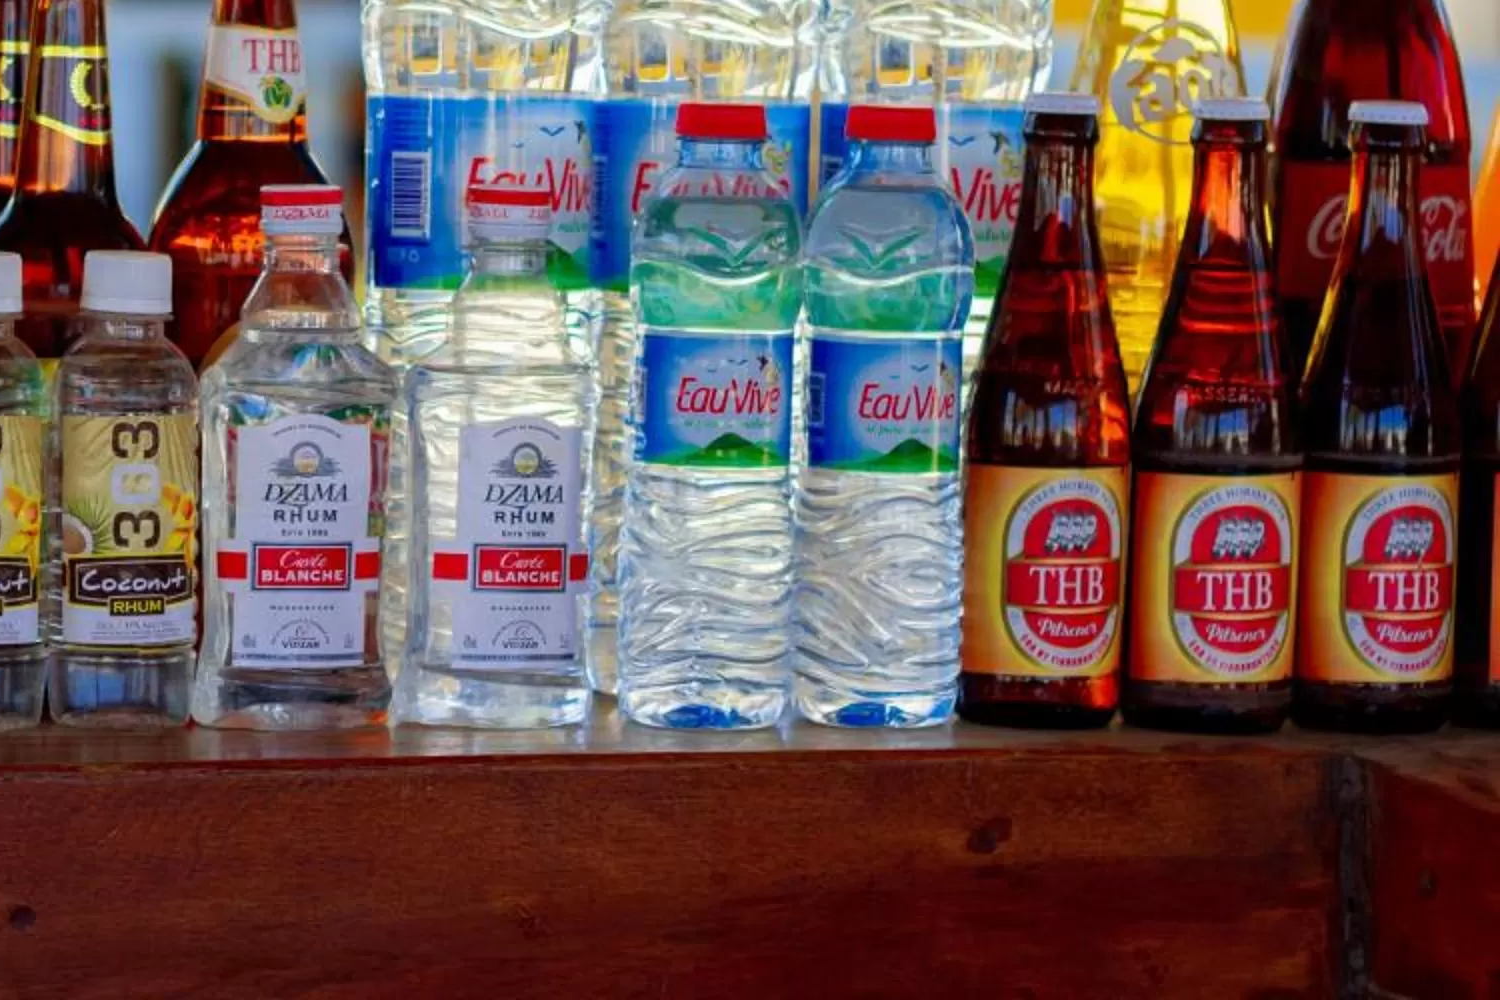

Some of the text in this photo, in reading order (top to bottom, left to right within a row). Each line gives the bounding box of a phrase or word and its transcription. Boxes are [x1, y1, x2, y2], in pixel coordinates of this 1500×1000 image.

[264, 483, 348, 506] DZAMA
[483, 484, 564, 507] DZAMA
[273, 509, 338, 523] RHUM
[494, 511, 555, 524] RHUM
[81, 568, 186, 593] Coconut
[261, 568, 344, 582] BLANCHE
[481, 570, 562, 583] BLANCHE
[1029, 565, 1104, 605] THB
[1196, 571, 1273, 611] THB
[1368, 571, 1440, 611] THB
[112, 600, 162, 614] RHUM
